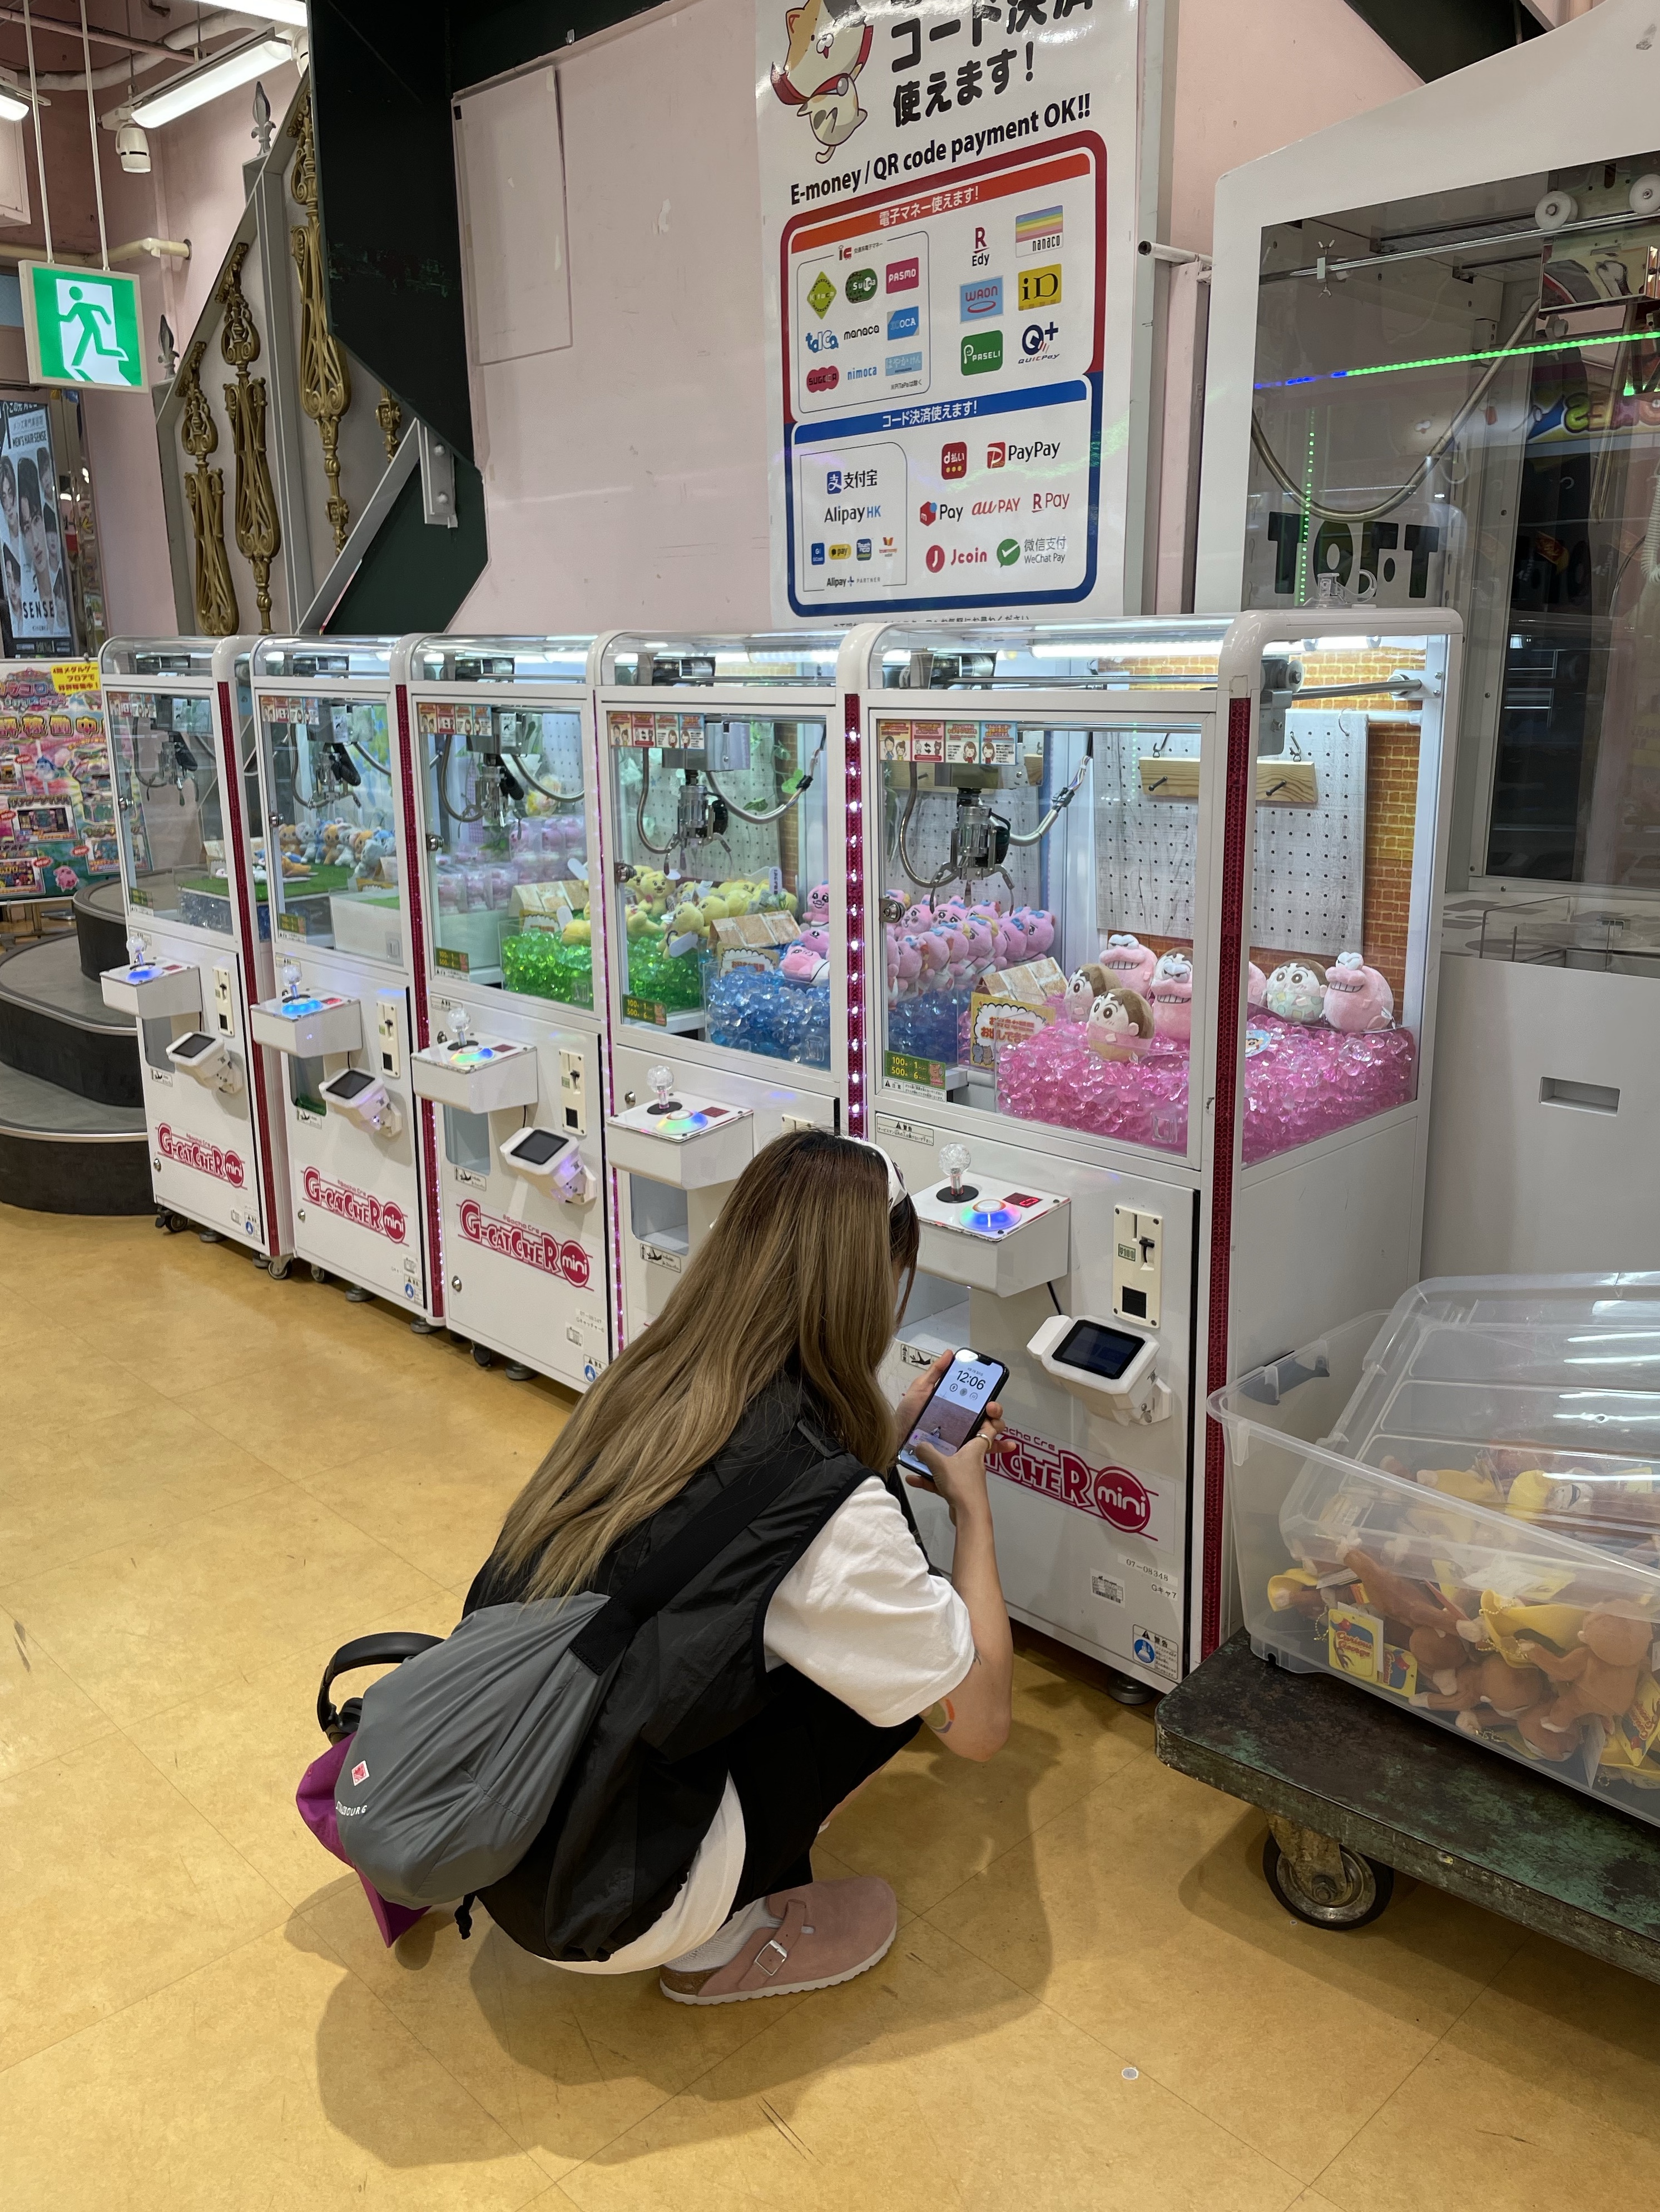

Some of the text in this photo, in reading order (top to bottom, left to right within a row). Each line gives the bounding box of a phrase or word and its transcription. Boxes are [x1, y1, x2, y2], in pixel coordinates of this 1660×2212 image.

[893, 41, 1033, 127] 使えます!
[791, 168, 861, 205] E-money
[874, 155, 900, 180] QR
[903, 140, 945, 171] code
[952, 111, 1039, 163] payment
[1044, 93, 1091, 128] OK!!
[879, 186, 979, 227] 電子マネー使えます!
[1032, 235, 1061, 252] nanaco
[972, 254, 990, 267] Edy
[853, 277, 876, 291] Suica
[888, 269, 916, 282] PASMO
[965, 285, 998, 302] WAON
[1022, 273, 1059, 301] iD
[844, 325, 880, 340] manaca
[972, 350, 1000, 363] PASELI
[847, 366, 878, 380] nimoca
[883, 400, 978, 428] コード決済使えます!
[1008, 441, 1061, 463] PayPay
[844, 469, 878, 490] 支付宝
[972, 497, 1022, 516] au PAY
[1045, 493, 1071, 510] Pay
[939, 504, 964, 522] Pay
[1024, 535, 1066, 553] 微信支付
[1024, 553, 1066, 564] WeChat Pay
[23, 601, 54, 619] SENSE
[226, 1162, 242, 1177] mini
[384, 1214, 404, 1233] mini
[562, 1254, 587, 1276] mini
[957, 1370, 986, 1390] 12:06
[1034, 1436, 1056, 1451] Cre
[1097, 1486, 1146, 1517] mini
[1336, 1631, 1372, 1650] Curious
[1336, 1640, 1371, 1659] George
